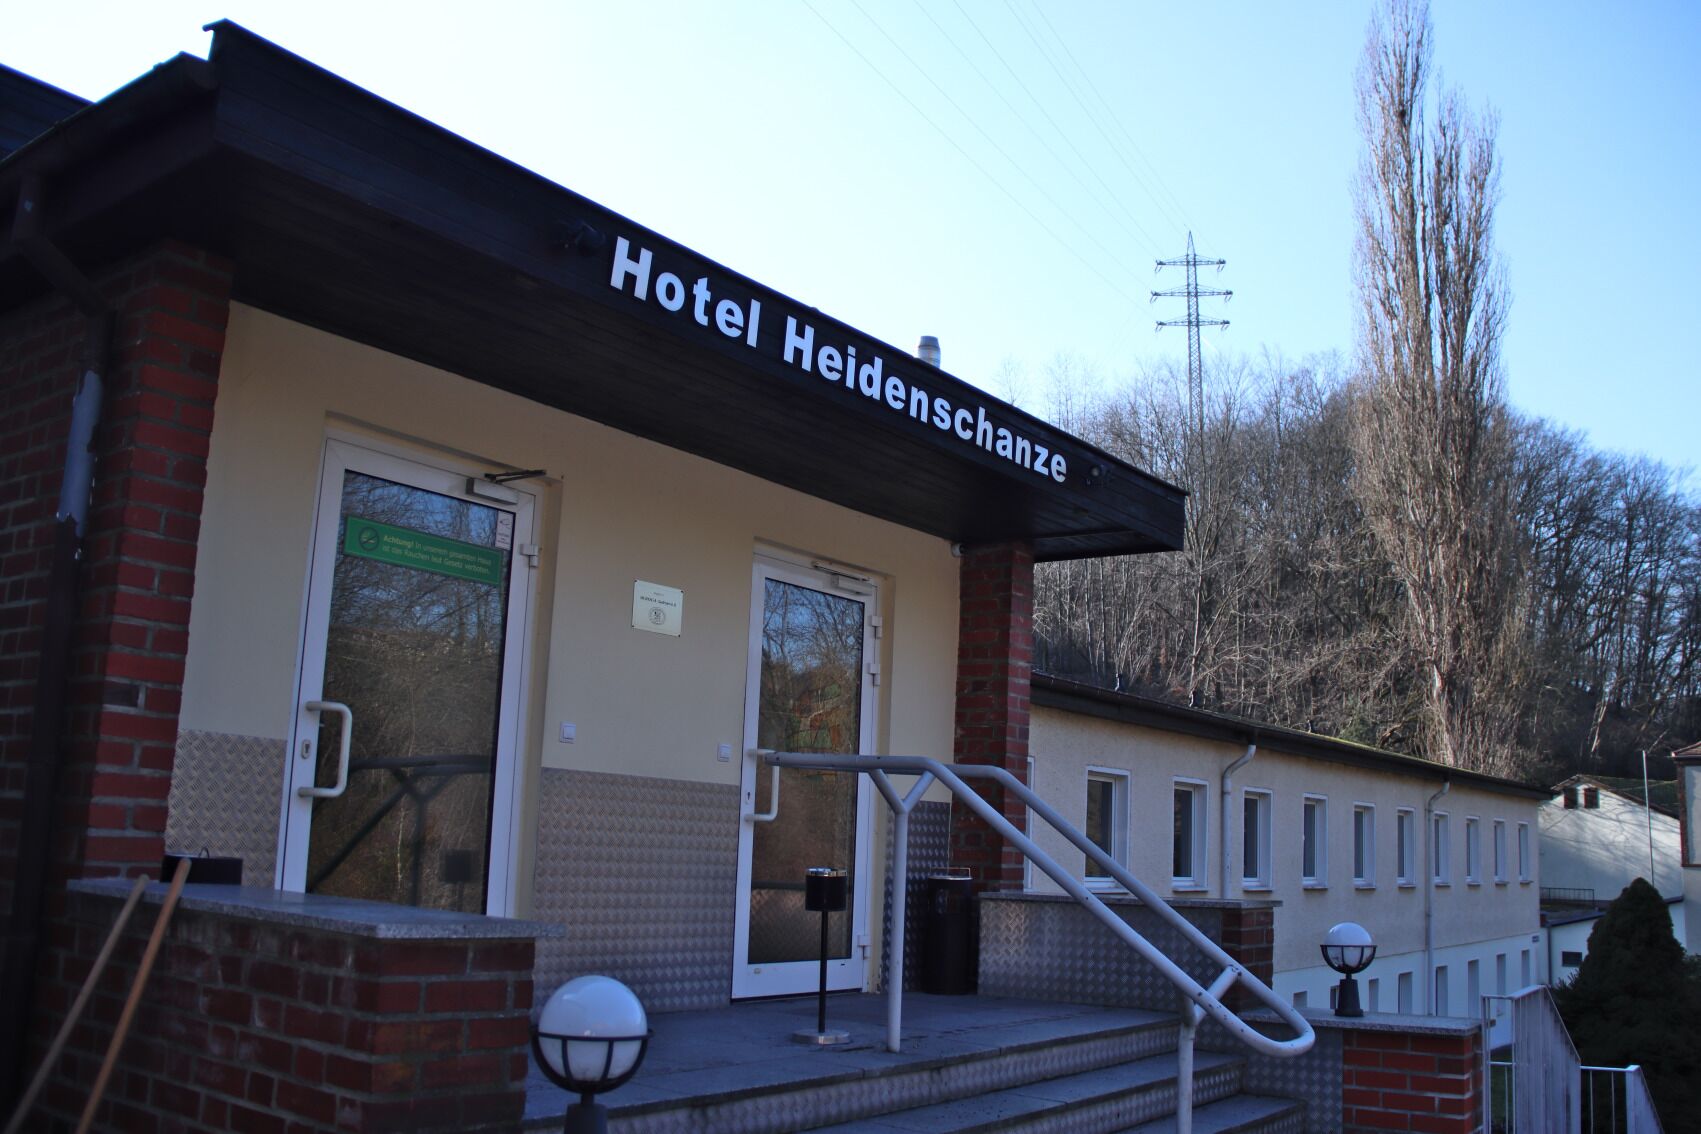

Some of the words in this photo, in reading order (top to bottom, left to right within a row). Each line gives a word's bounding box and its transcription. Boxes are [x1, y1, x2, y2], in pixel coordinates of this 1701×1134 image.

[610, 236, 761, 347] Hotel
[783, 315, 1067, 482] Heidenschanze
[383, 535, 414, 548] Achtung!
[403, 550, 430, 561] Rauchen
